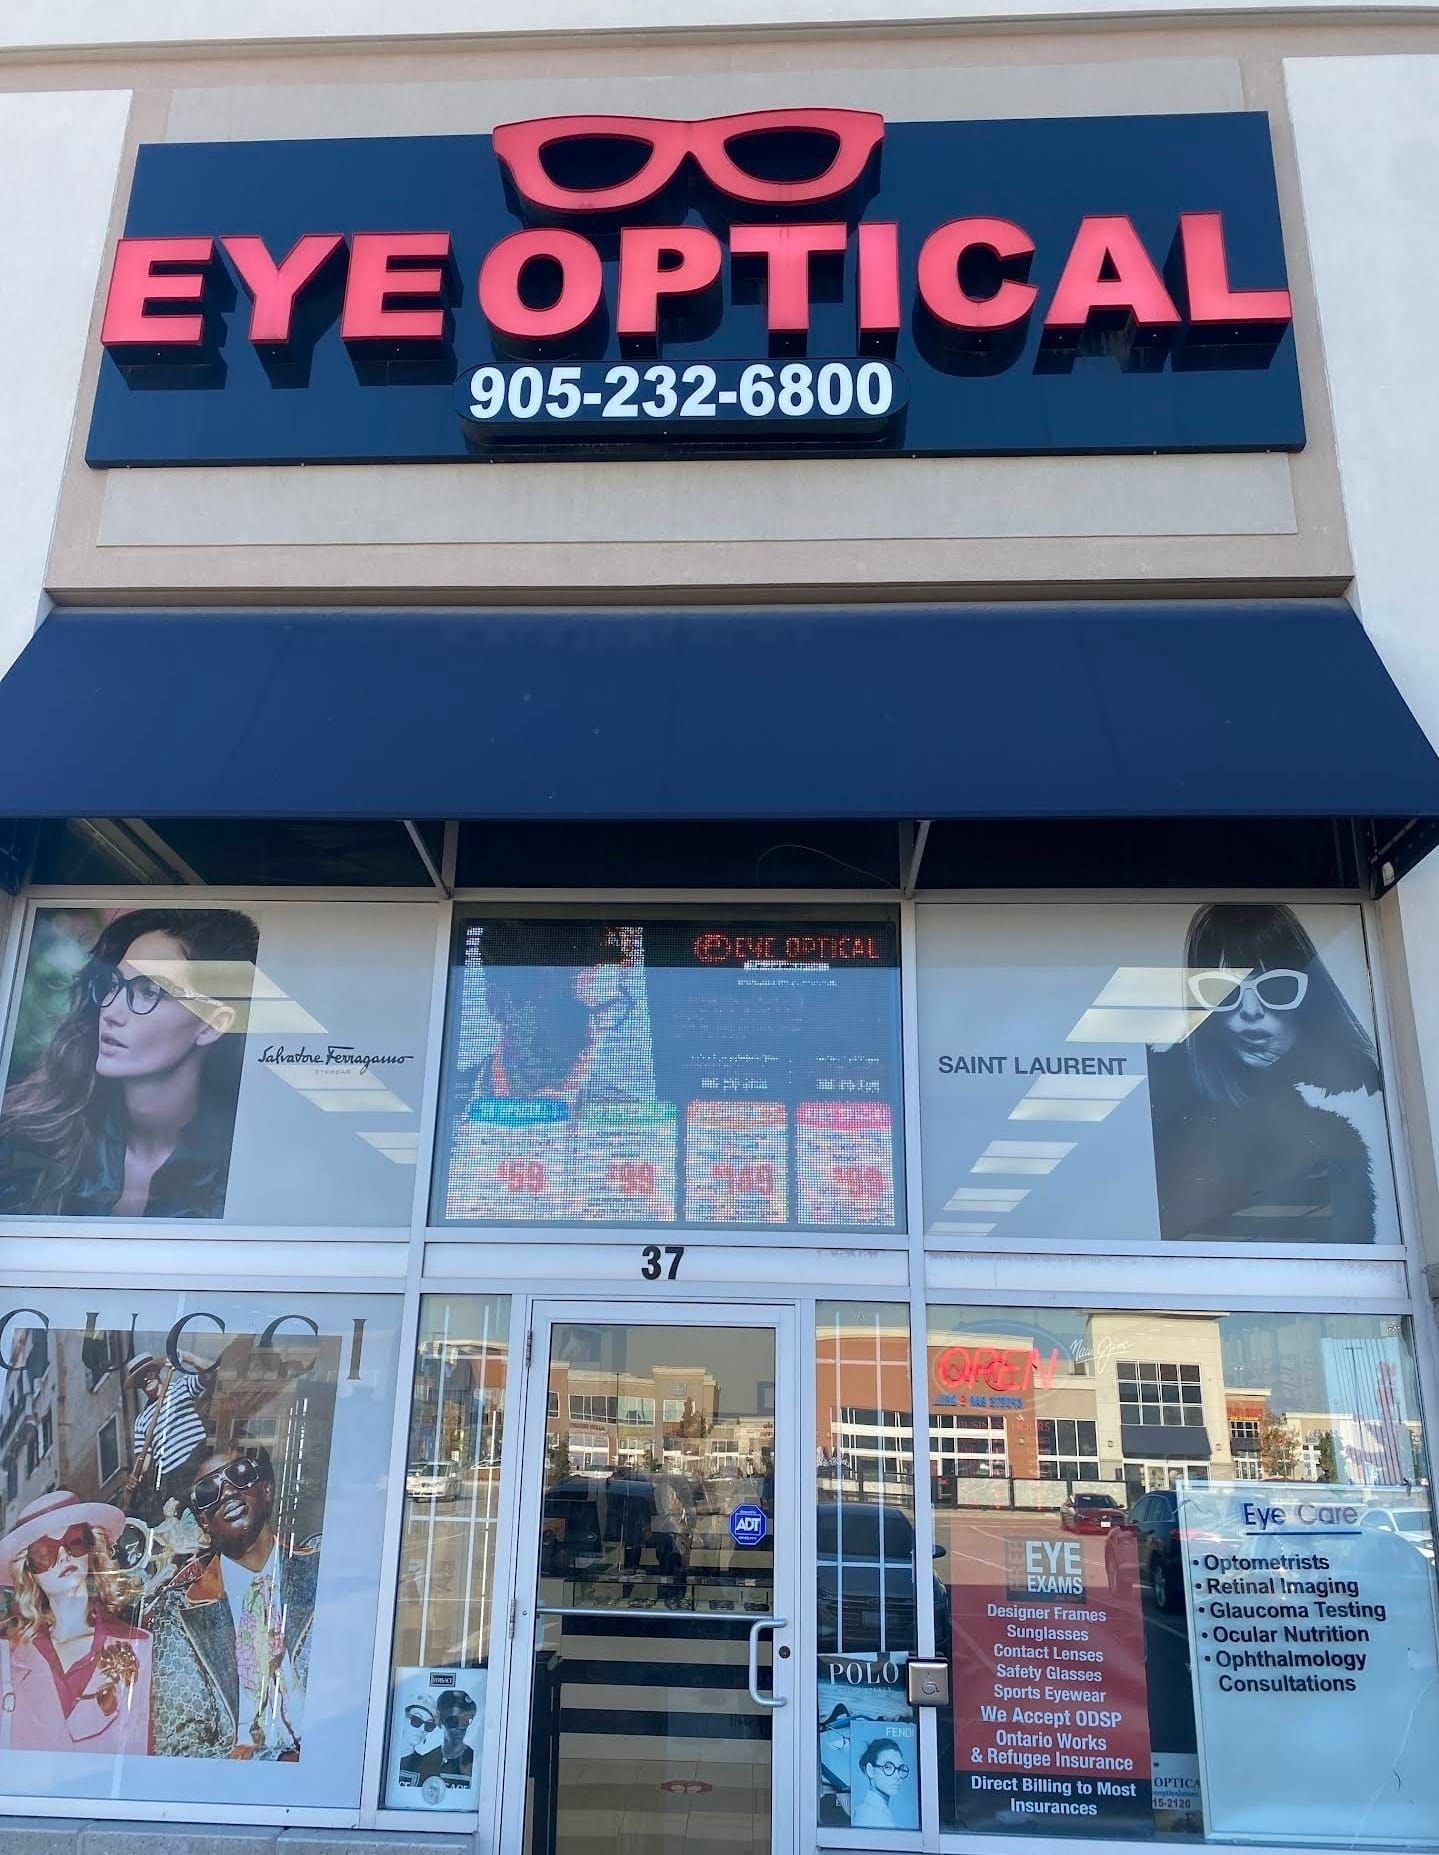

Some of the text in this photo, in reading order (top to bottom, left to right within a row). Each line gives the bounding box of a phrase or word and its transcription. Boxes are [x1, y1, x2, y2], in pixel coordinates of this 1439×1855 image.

[468, 361, 894, 422] 905-232-6800
[786, 937, 880, 959] OPTICAL
[258, 1045, 414, 1075] Salvatore Ferragamo
[938, 1055, 1127, 1076] SAINT LAURENT
[641, 1246, 684, 1280] 37
[938, 1346, 1058, 1391] OPEN
[735, 1517, 761, 1532] ADT
[1242, 1503, 1358, 1530] Eye Care
[1025, 1540, 1082, 1575] EYE
[1204, 1554, 1330, 1574] Optometrists
[1027, 1574, 1083, 1595] EXAMS
[1207, 1578, 1359, 1597] Retinal Imaging
[987, 1604, 1107, 1622] Designer Frames
[1210, 1601, 1386, 1621] Glaucoma Testing
[1007, 1624, 1089, 1642] Sunglasses
[1213, 1625, 1370, 1643] Ocular Nutrition
[993, 1644, 1104, 1662] Contact Lenses
[1215, 1650, 1367, 1671] Ophthalmology
[829, 1662, 899, 1685] POLO
[996, 1664, 1103, 1683] Safety Glasses
[1218, 1674, 1357, 1692] Consultations
[993, 1684, 1107, 1703] Sports Eyewear
[980, 1705, 1122, 1728] We Accept ODSP
[886, 1727, 915, 1737] FENDI
[996, 1730, 1107, 1751] Ontario Works
[971, 1748, 1133, 1770] & Refugee Insurance
[971, 1776, 1018, 1792] Direct
[1022, 1778, 1072, 1796] Billing
[1076, 1780, 1093, 1796] to
[1097, 1782, 1137, 1797] Most
[1010, 1798, 1098, 1816] Insurances
